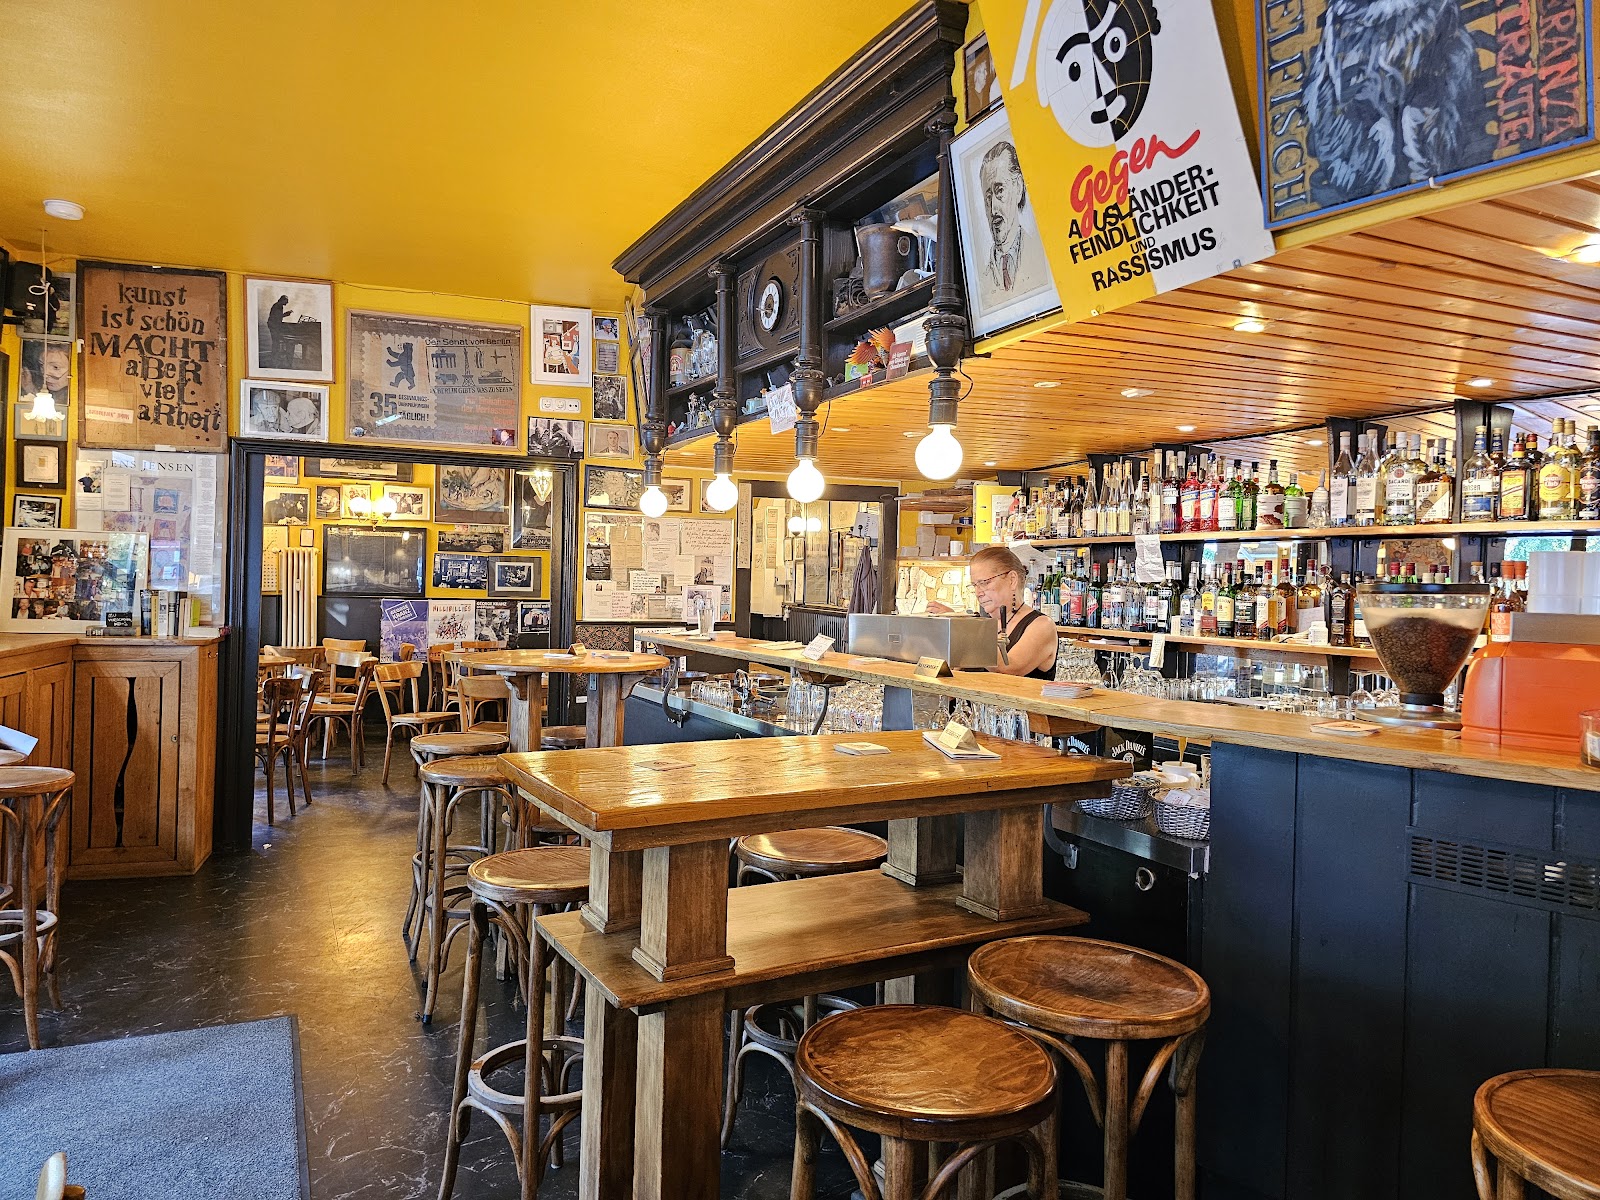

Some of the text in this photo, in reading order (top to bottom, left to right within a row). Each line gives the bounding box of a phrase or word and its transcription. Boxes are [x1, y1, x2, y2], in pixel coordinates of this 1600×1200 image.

[1069, 181, 1219, 265] FEINDLICHKEIT
[1130, 235, 1156, 254] UND
[1091, 227, 1217, 292] RASSISMUS
[118, 282, 188, 307] kunst
[101, 305, 205, 336] ist schön
[90, 332, 215, 363] MACHT
[442, 338, 469, 346] Senat
[486, 338, 511, 346] Berlin
[370, 391, 398, 418] 35
[104, 458, 194, 473] JENS JENSEN
[1111, 742, 1125, 758] JACK
